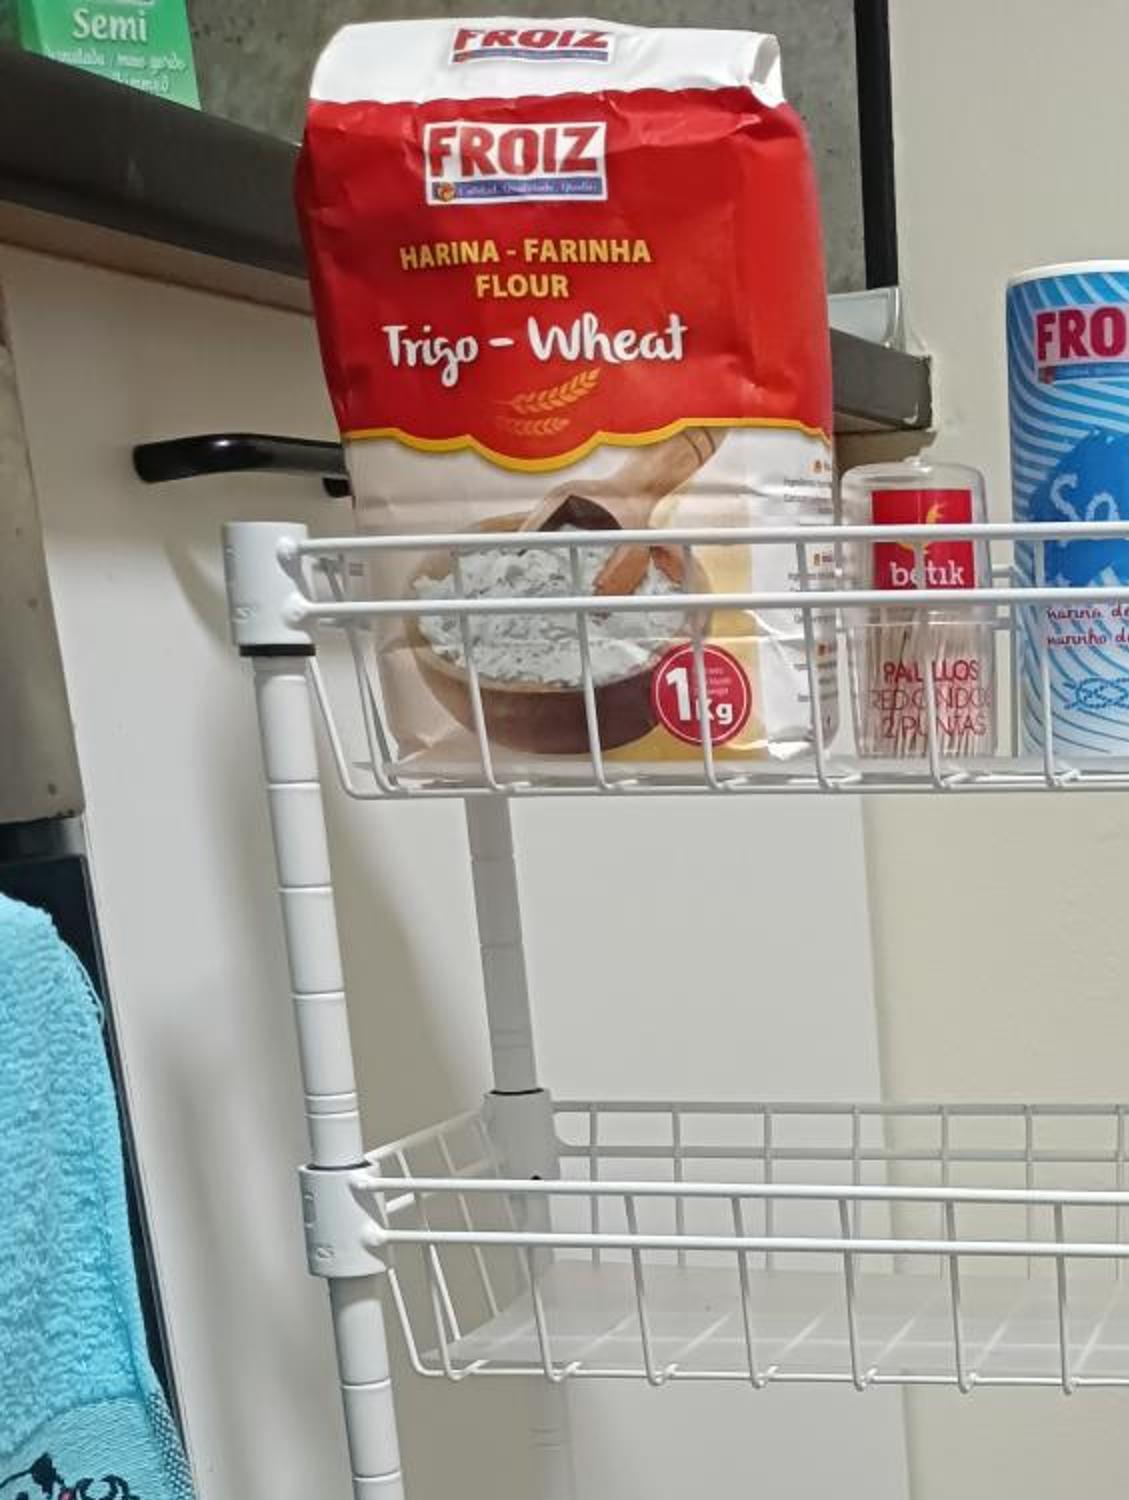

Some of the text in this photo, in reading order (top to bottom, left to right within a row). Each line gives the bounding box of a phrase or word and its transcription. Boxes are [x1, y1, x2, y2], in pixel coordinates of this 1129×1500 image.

[71, 8, 148, 42] Semi
[453, 28, 611, 51] FROIZ
[429, 126, 600, 177] FROIZ
[400, 239, 500, 270] HARINA
[523, 239, 652, 263] FARINHA
[475, 273, 570, 298] FLOUR
[381, 323, 479, 388] Trigo
[526, 311, 689, 364] Wheat
[884, 659, 982, 684] PALLLOS
